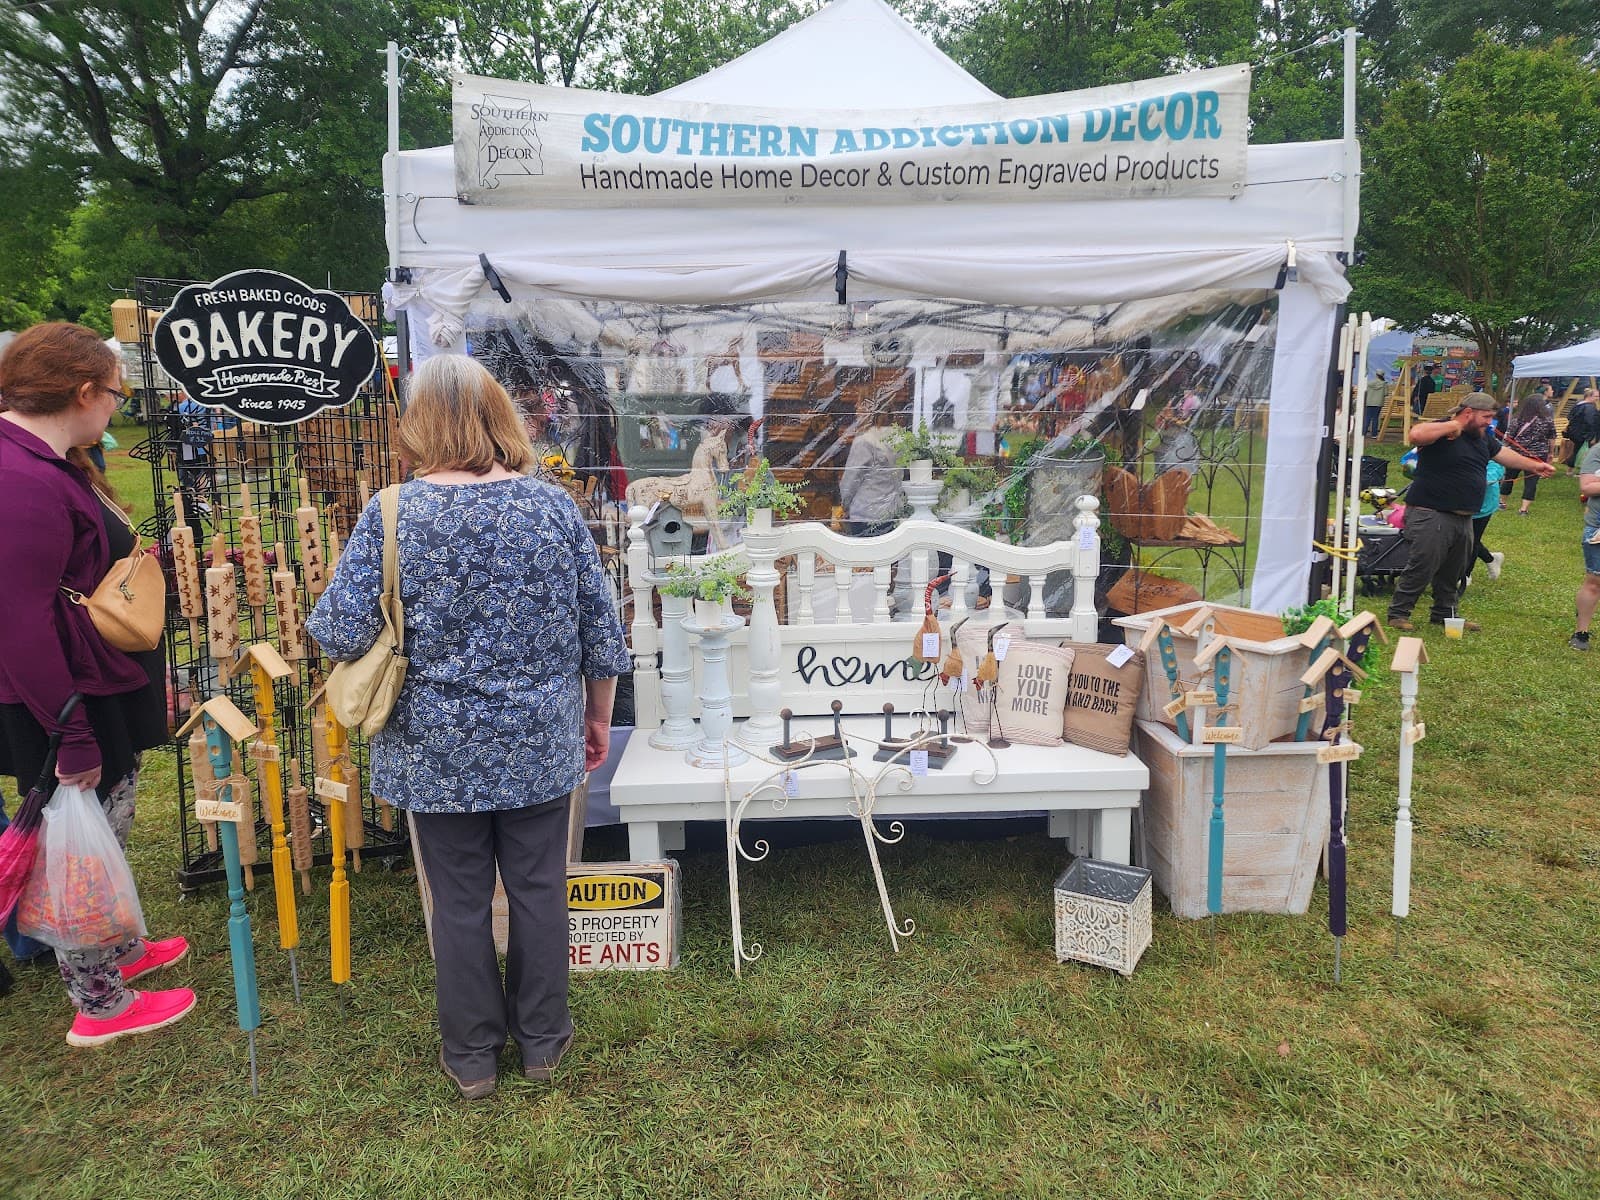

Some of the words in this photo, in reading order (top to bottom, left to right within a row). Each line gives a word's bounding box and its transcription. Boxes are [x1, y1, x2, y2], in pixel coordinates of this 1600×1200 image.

[471, 103, 549, 121] SOUTHERN
[480, 125, 536, 136] ADDICTION
[581, 112, 818, 157] SOUTHERN
[829, 114, 1069, 155] ADDICTION
[1081, 90, 1221, 142] DECOR
[580, 163, 713, 190] Handmade
[722, 163, 793, 189] Home
[801, 162, 870, 189] Decor
[877, 161, 892, 187] &
[900, 160, 989, 186] Custom
[999, 155, 1106, 189] Engraved
[1116, 152, 1219, 181] Products
[194, 289, 237, 308] FRESH
[239, 288, 281, 302] BAKED
[284, 291, 327, 314] GOODS
[169, 310, 359, 369] BAKERY
[220, 369, 294, 386] Homemade
[294, 369, 321, 388] Pies
[238, 397, 273, 410] Since
[277, 398, 306, 410] 1945
[1017, 664, 1053, 682] LOVE
[1017, 679, 1051, 700] YOU
[1074, 672, 1089, 690] YOU
[1091, 675, 1101, 693] TO
[1102, 678, 1121, 698] THE
[1011, 697, 1049, 716] MORE
[1072, 691, 1091, 709] AND
[1091, 695, 1119, 715] BACK
[569, 882, 647, 902] AUTION
[582, 915, 659, 931] PROPERTY
[629, 931, 644, 941] BY
[569, 944, 592, 965] RE
[599, 942, 660, 964] ANTS
